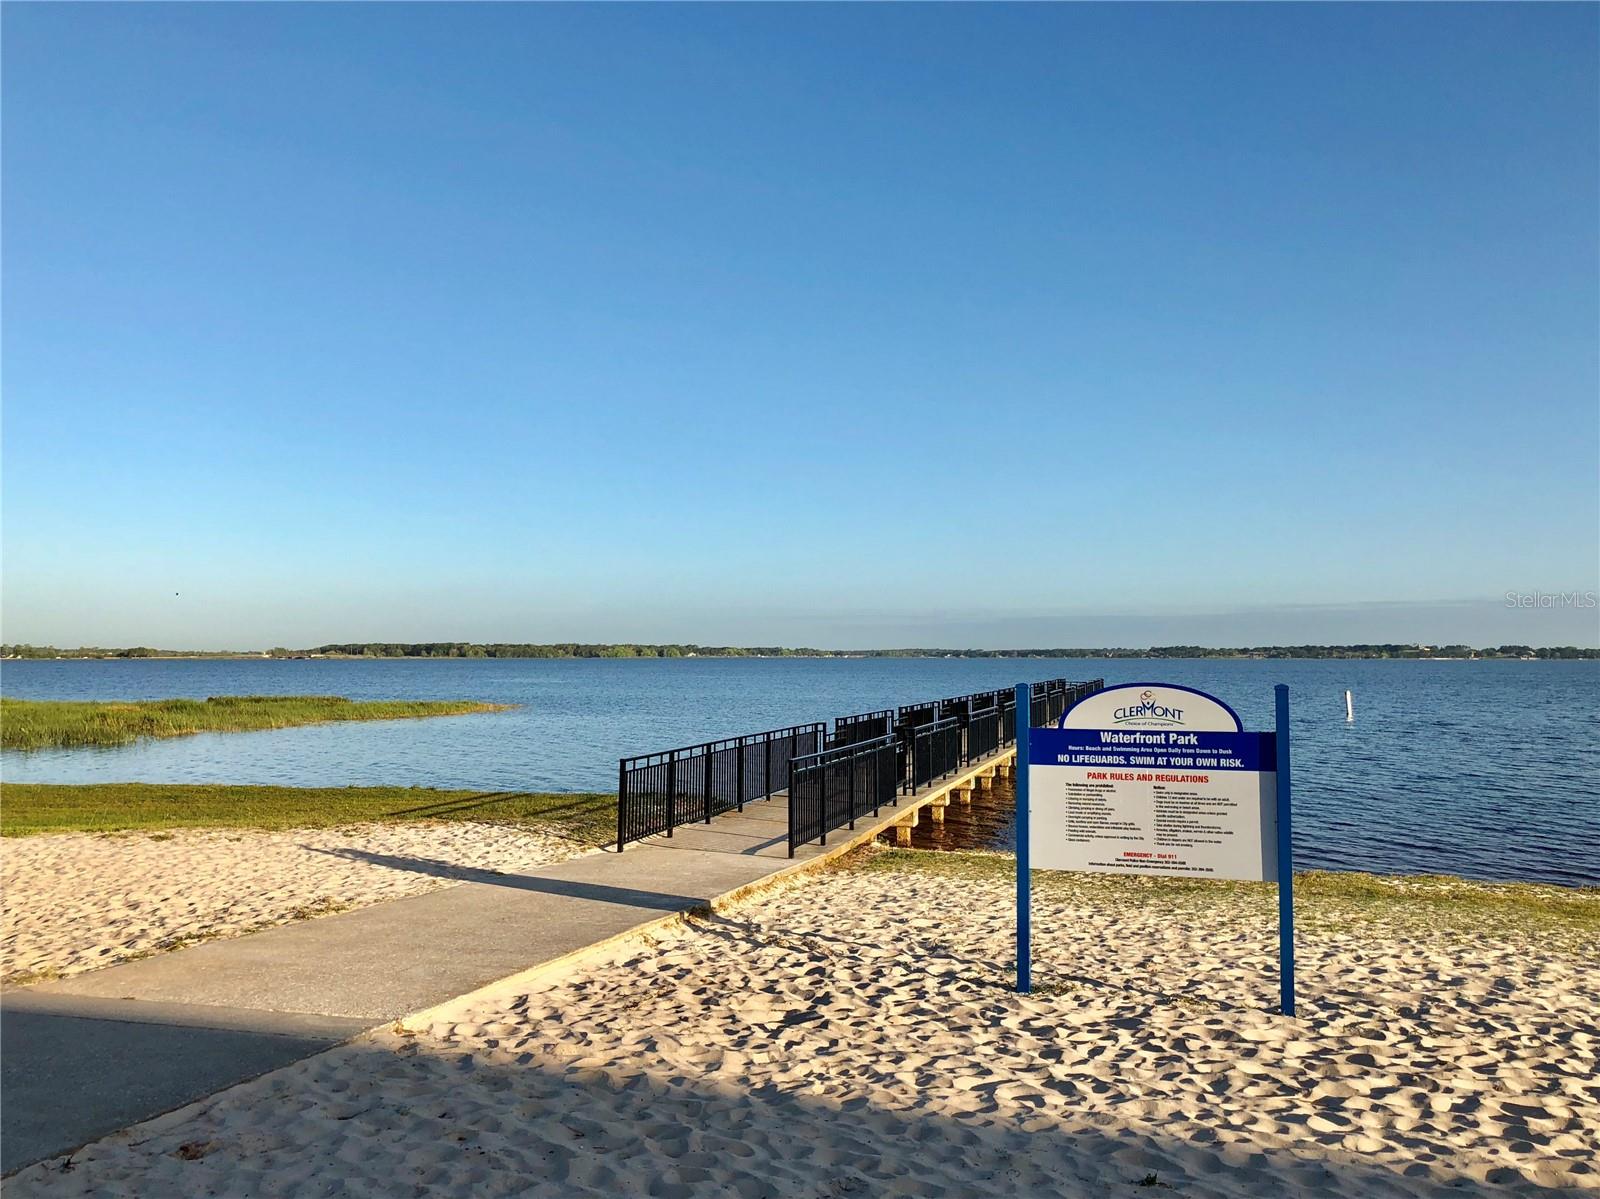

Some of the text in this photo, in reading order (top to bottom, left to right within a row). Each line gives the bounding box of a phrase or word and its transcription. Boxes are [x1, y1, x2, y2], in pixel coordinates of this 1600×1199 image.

[1113, 699, 1184, 721] CLERMONT
[1100, 732, 1198, 746] Waterfront Park
[1113, 746, 1140, 754] Swimming
[1057, 754, 1245, 768] NO LIFEGUARDS. SWIM AT YOUR OWN RISK.
[1087, 772, 1209, 784] PARK RULES AND REGULATIONS
[1123, 851, 1153, 859] EMERGENCY
